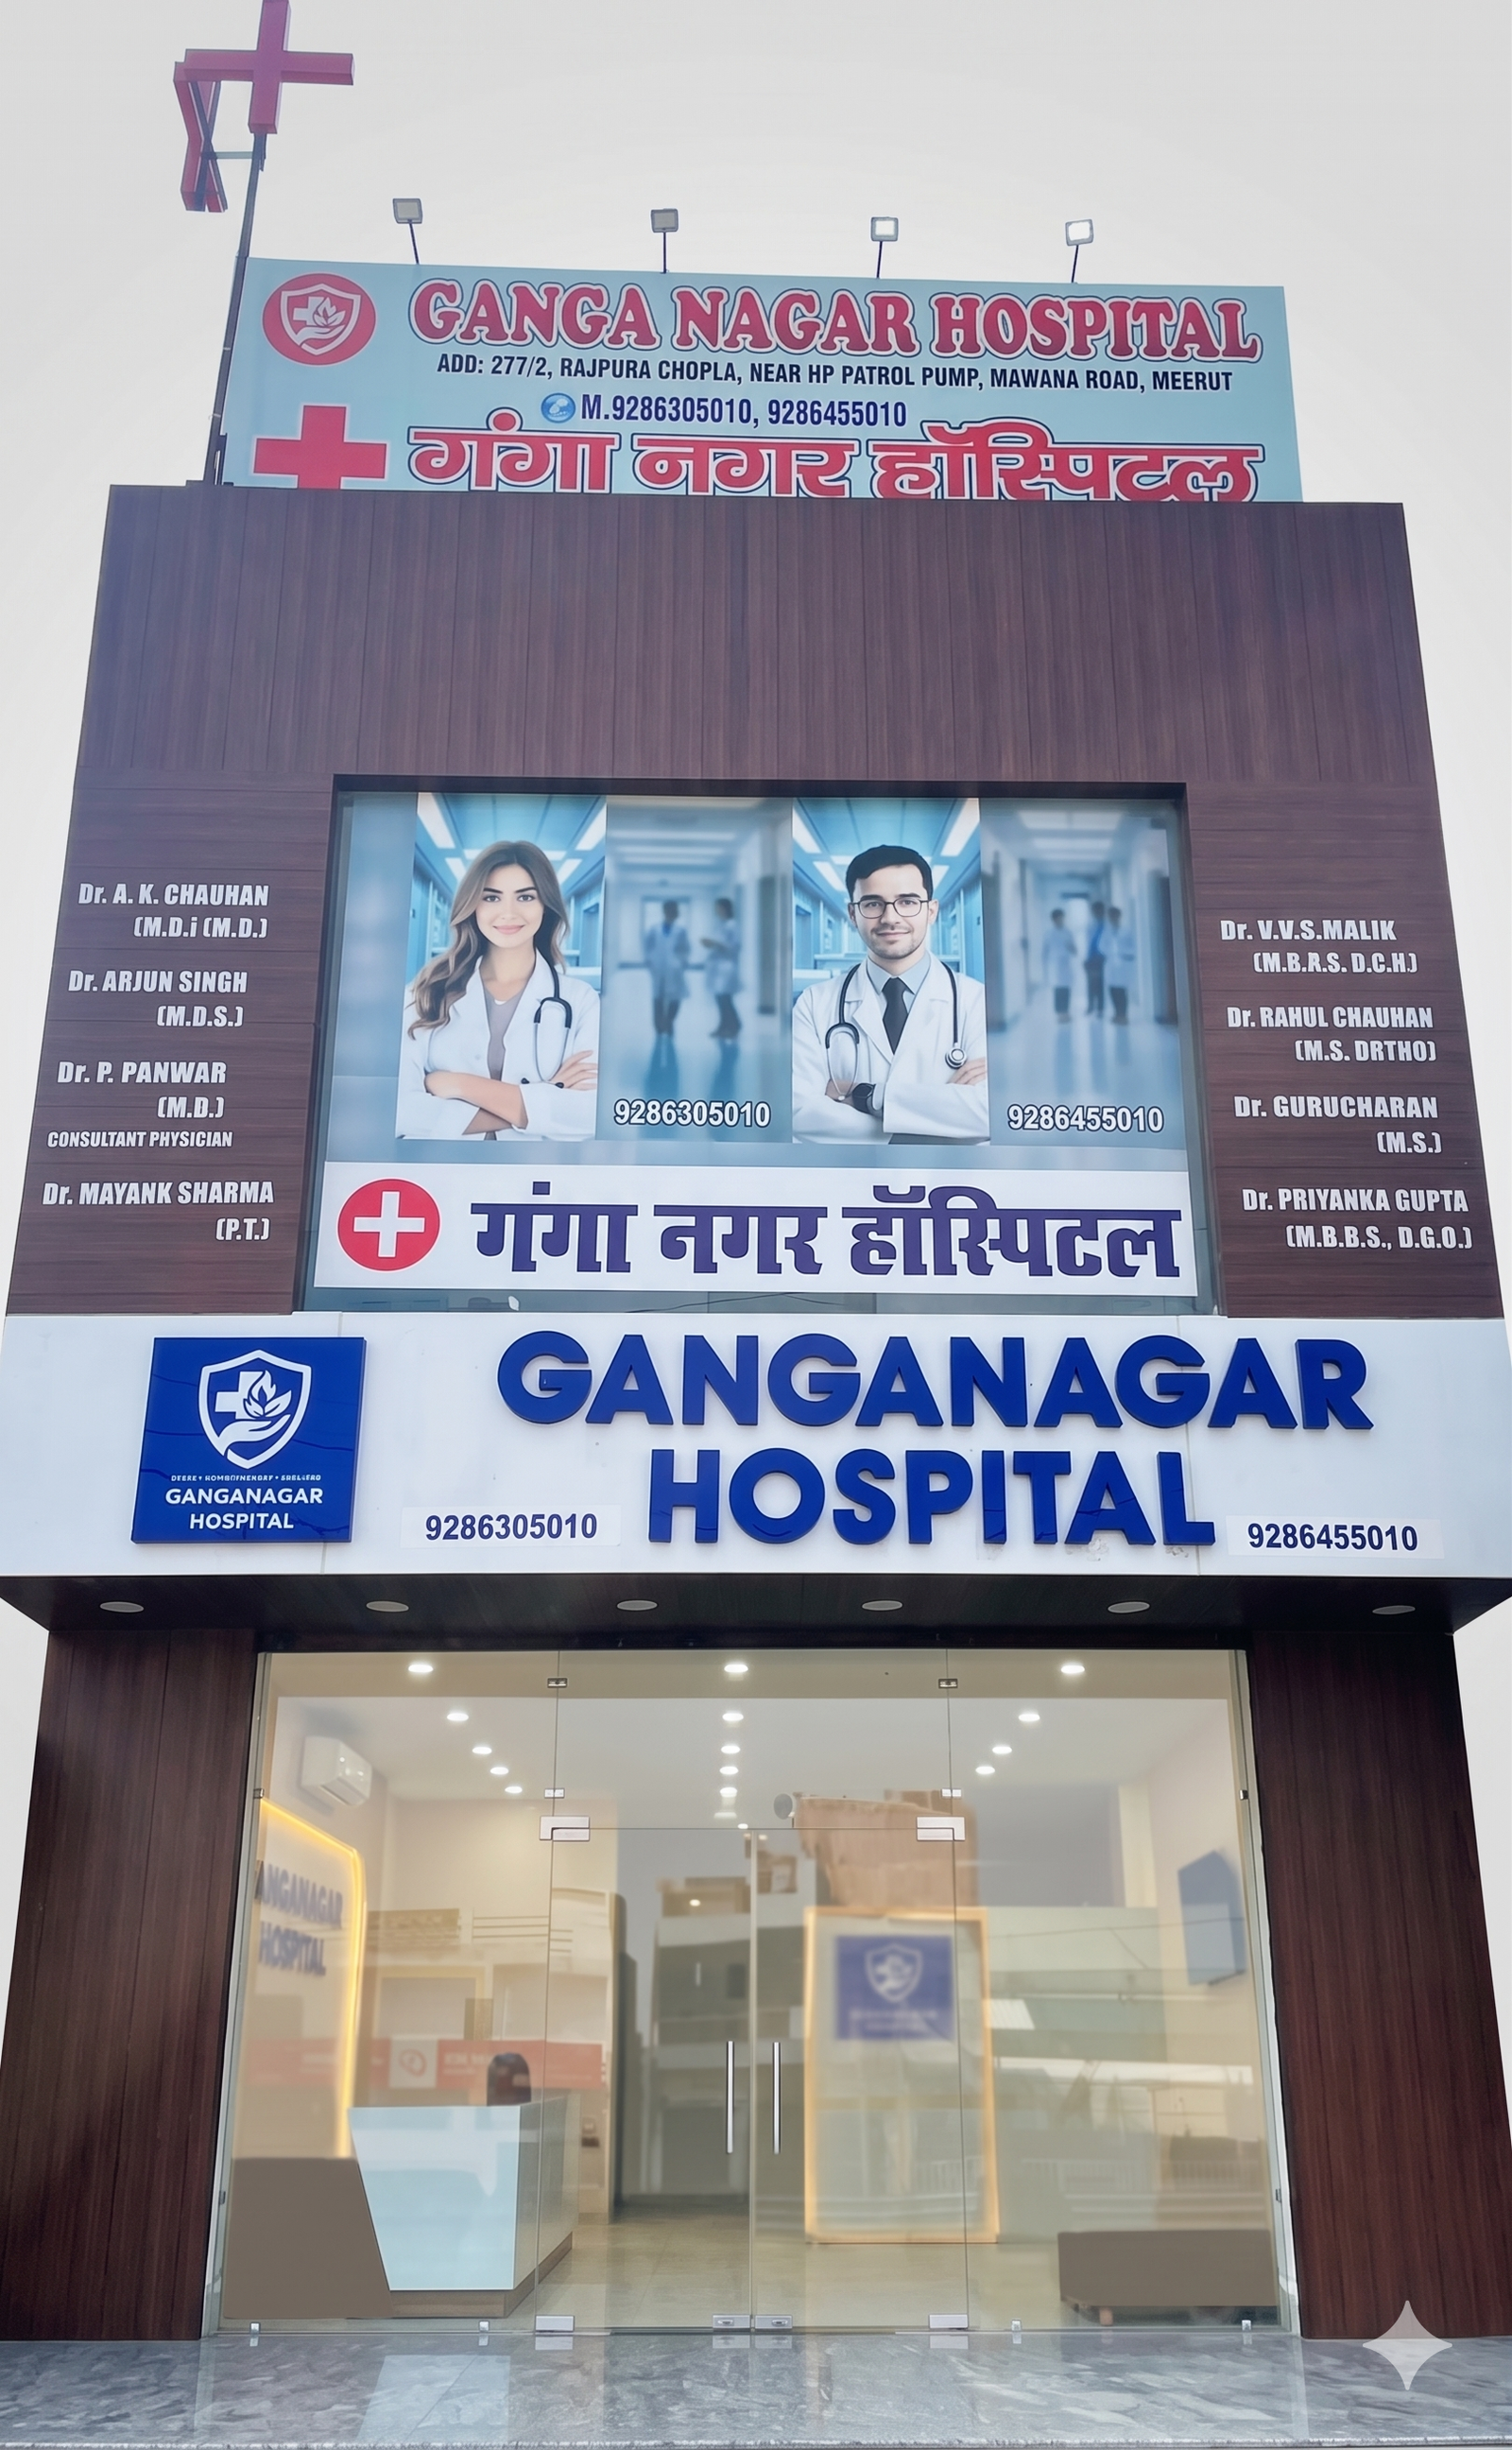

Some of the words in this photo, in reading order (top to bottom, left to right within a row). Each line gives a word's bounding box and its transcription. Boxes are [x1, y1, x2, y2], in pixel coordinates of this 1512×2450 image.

[408, 278, 662, 348] GANGA
[670, 285, 920, 357] NAGAR
[930, 293, 1263, 363] HOSPITAL
[438, 354, 485, 374] ADD:
[491, 355, 553, 380] 277/2,
[560, 358, 651, 379] RAJPURA
[658, 360, 742, 386] CHOPLA,
[749, 363, 801, 383] NEAR
[808, 364, 834, 384] HP
[842, 365, 915, 386] PATROL
[922, 367, 983, 391] PUMP,
[990, 368, 1079, 389] MAWANA
[1086, 370, 1145, 393] ROAD,
[1152, 371, 1232, 391] MEERUT
[580, 394, 759, 428] M.9286305010,
[767, 400, 907, 427] 9286455010
[407, 407, 620, 493] गंगा
[631, 432, 860, 497] नगर
[867, 417, 1264, 502] हॉस्पिटल
[78, 884, 107, 904] Dr.
[112, 884, 133, 905] A.
[138, 884, 159, 905] K.
[164, 884, 269, 906] CHAUHAN
[202, 917, 268, 938] (M.D.)
[1220, 920, 1253, 940] Dr.
[1257, 920, 1397, 940] V.V.S.MALIK
[68, 970, 98, 992] Dr.
[102, 971, 173, 992] ARJUN
[179, 971, 248, 993] SINGH
[157, 1006, 244, 1027] (M.D.S.)
[1227, 1007, 1256, 1027] Dr.
[1260, 1007, 1329, 1027] RAHUL
[1332, 1007, 1434, 1028] CHAUHAN
[1295, 1040, 1350, 1061] (M.S.
[57, 1061, 90, 1083] Dr.
[96, 1061, 114, 1083] P.
[121, 1061, 227, 1084] PANWAR
[157, 1096, 224, 1118] (M.D.)
[613, 1098, 770, 1128] 9286305010
[1006, 1104, 1164, 1132] 9286455010
[1234, 1096, 1267, 1117] Dr.
[1273, 1096, 1438, 1118] GURUCHARAN
[47, 1131, 146, 1147] CONSULTANT
[149, 1131, 232, 1147] PHYSICIAN
[1377, 1131, 1441, 1153] (M.S.)
[43, 1182, 73, 1205] Dr.
[79, 1182, 172, 1205] MAYANK
[177, 1182, 274, 1204] SHARMA
[1242, 1188, 1273, 1210] Dr.
[1279, 1188, 1390, 1211] PRIYANKA
[1395, 1189, 1469, 1212] GUPTA
[215, 1218, 270, 1240] (P.T.)
[471, 1181, 638, 1273] गंगा
[653, 1204, 828, 1275] नगर
[841, 1185, 1181, 1278] हॉस्पिटल
[1285, 1225, 1392, 1251] (M.B.B.S.,
[1399, 1226, 1472, 1249] D.G.O.)
[497, 1330, 1374, 1430] GANGANAGAR
[165, 1488, 323, 1505] GANGANAGAR
[648, 1447, 1215, 1546] HOSPITAL
[189, 1512, 294, 1529] HOSPITAL
[425, 1513, 597, 1541] 9286305010
[1247, 1523, 1418, 1552] 9286455010
